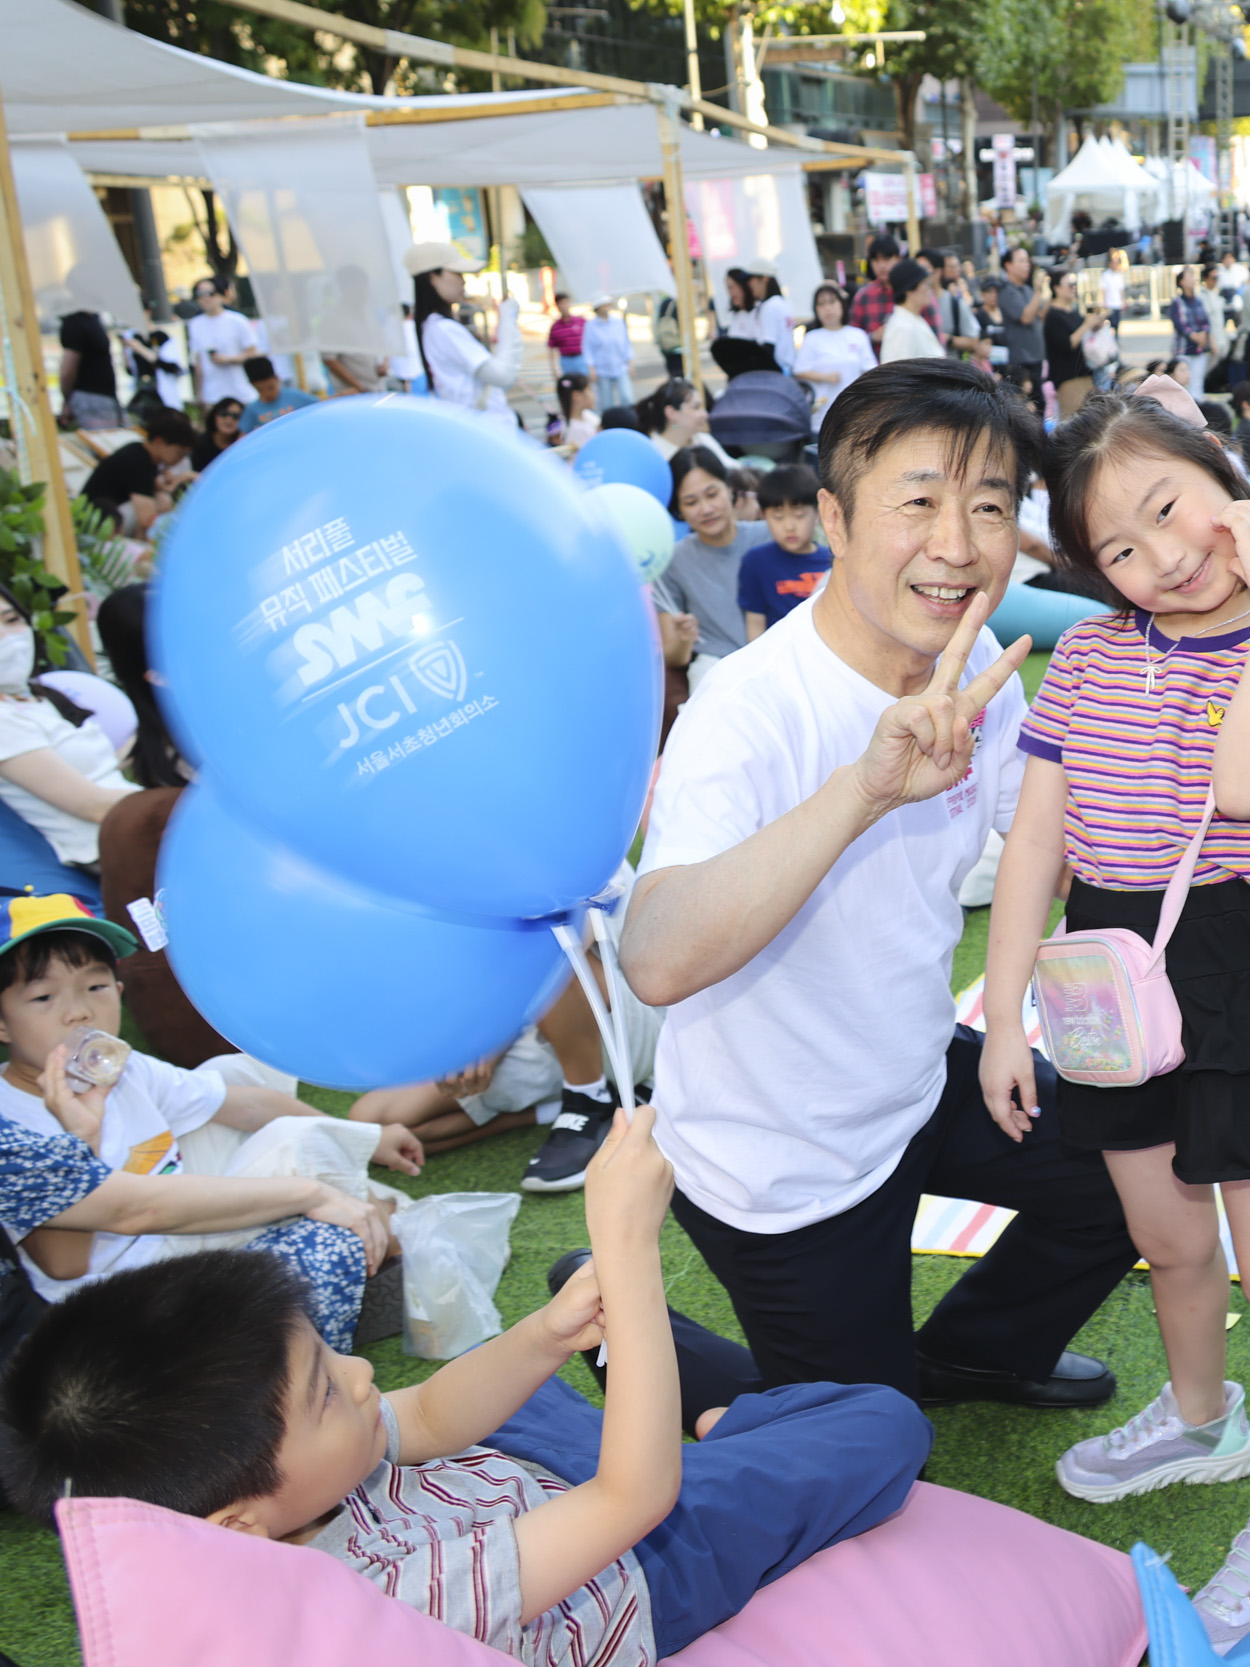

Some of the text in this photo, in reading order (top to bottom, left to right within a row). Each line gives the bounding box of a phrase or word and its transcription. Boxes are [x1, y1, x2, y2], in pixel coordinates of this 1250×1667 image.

[259, 530, 418, 632] 뮤직 페스티벌
[282, 516, 355, 576] 서리풀
[337, 674, 418, 749] JCI
[356, 693, 500, 776] 서울서초청년회의소
